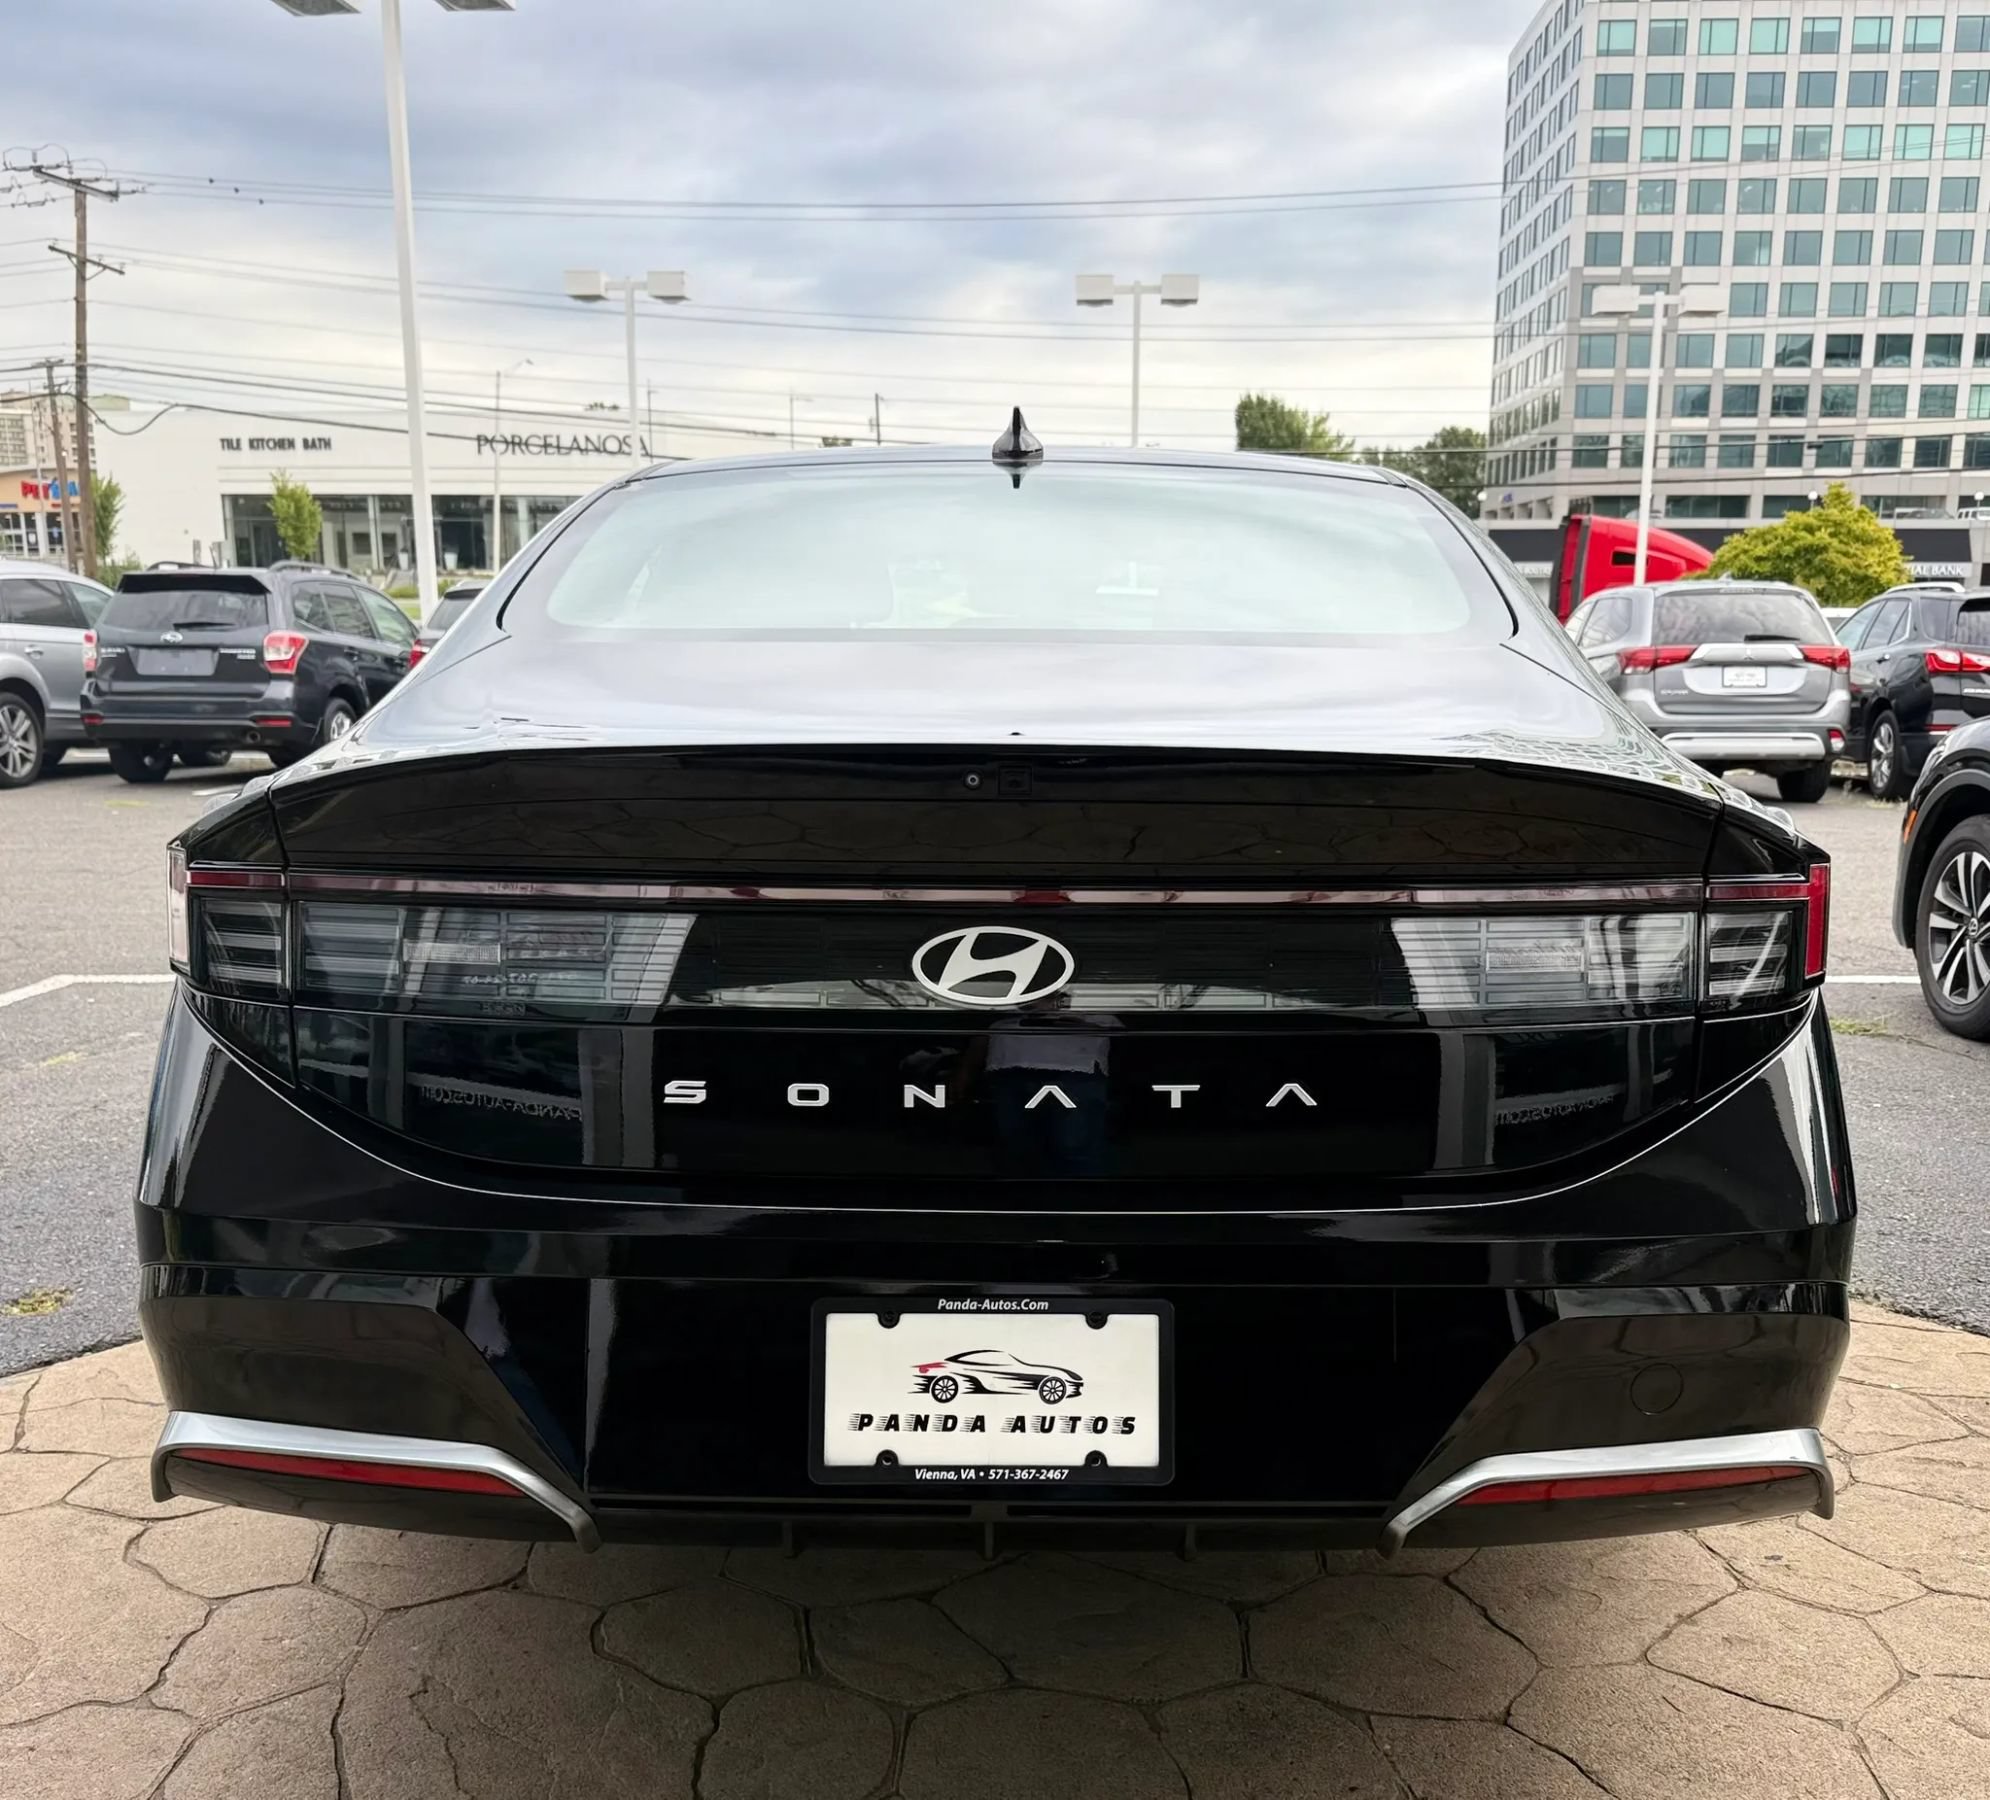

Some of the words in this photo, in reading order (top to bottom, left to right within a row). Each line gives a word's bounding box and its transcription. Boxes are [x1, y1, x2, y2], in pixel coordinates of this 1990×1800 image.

[219, 437, 242, 450] TILE
[248, 437, 295, 450] KITCHEN
[302, 437, 331, 450] BATH
[1931, 564, 1962, 577] BANK
[664, 1080, 1317, 1109] SONATA
[937, 1298, 1049, 1311] Panda-Autos.Com
[848, 1413, 985, 1434] PANDA
[1001, 1415, 1136, 1435] AUTOS
[914, 1468, 958, 1481] Vienna,
[960, 1468, 976, 1480] VA
[987, 1469, 1070, 1481] 571-367-2467
